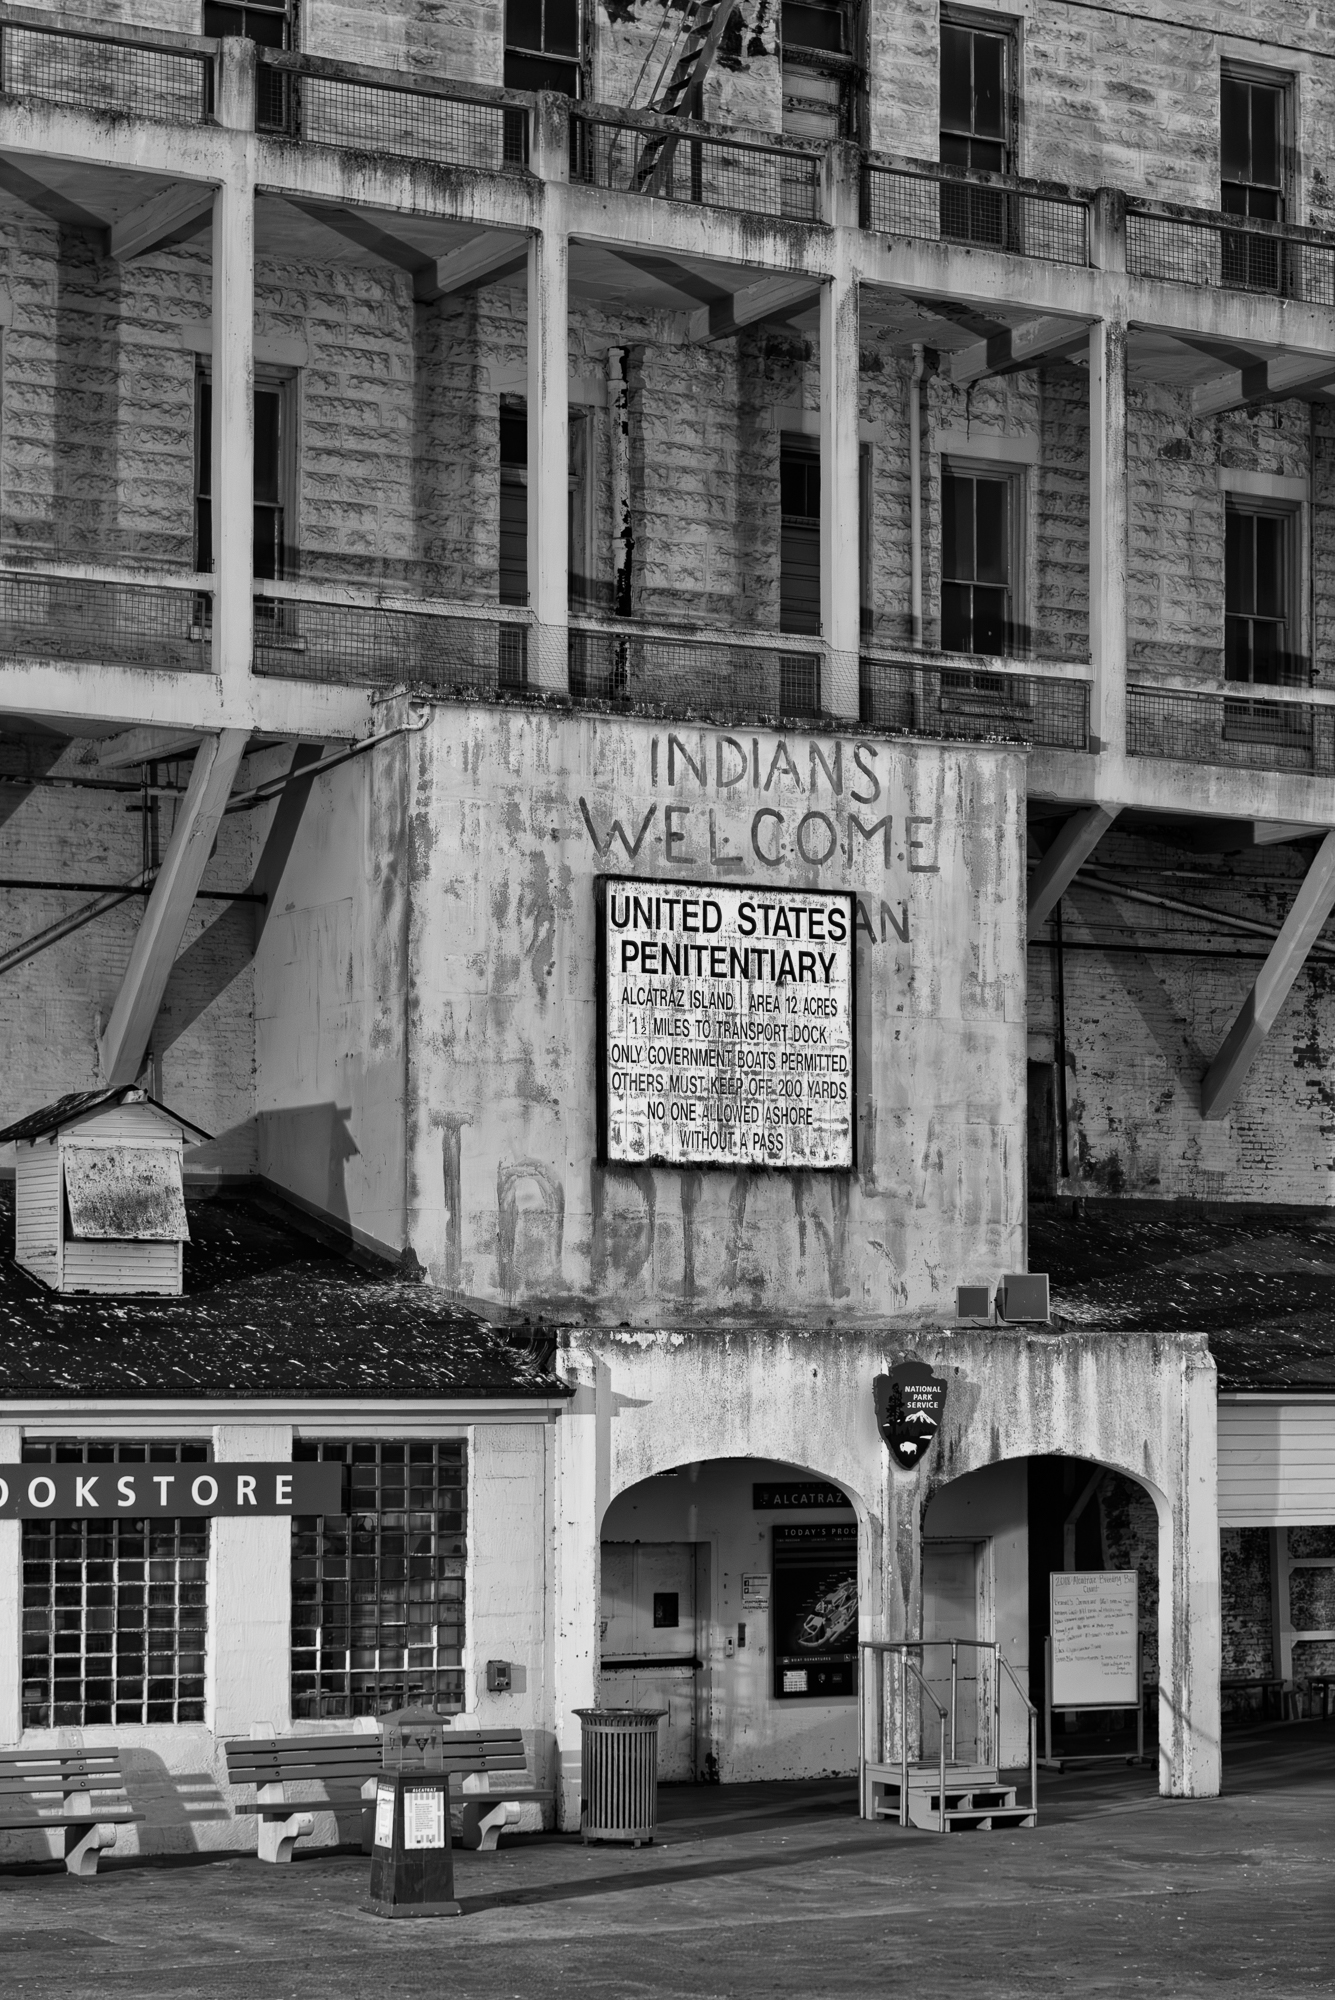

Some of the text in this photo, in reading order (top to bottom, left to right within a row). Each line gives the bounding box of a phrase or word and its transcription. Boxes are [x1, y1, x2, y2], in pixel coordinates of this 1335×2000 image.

[651, 733, 879, 804] INDIANS
[578, 796, 940, 873] WELCOME
[611, 894, 847, 941] UNITED STATES
[621, 939, 837, 984] PENITENTIARY
[621, 986, 838, 1016] ALCATRAZ ISLAND AREA 12 ACRES
[653, 1017, 690, 1038] MILES
[695, 1020, 711, 1038] TO
[717, 1020, 788, 1042] TRANSPORT
[793, 1025, 827, 1044] DOCK
[611, 1043, 643, 1064] ONLY
[648, 1046, 732, 1067] GOVERNMENT
[737, 1050, 776, 1070] BOATS
[612, 1071, 847, 1100] OTHERS MUST KEEP OFF 200 YARDS
[647, 1101, 813, 1126] NO ONE ALLOWED ASHORE
[680, 1129, 784, 1152] WITHOUT A PASS
[905, 1385, 941, 1393] NATIONAL
[913, 1393, 933, 1401] PARK
[907, 1401, 938, 1409] SERVICE
[773, 1492, 843, 1505] ALCATRAZ
[784, 1528, 827, 1537] TODAY'S
